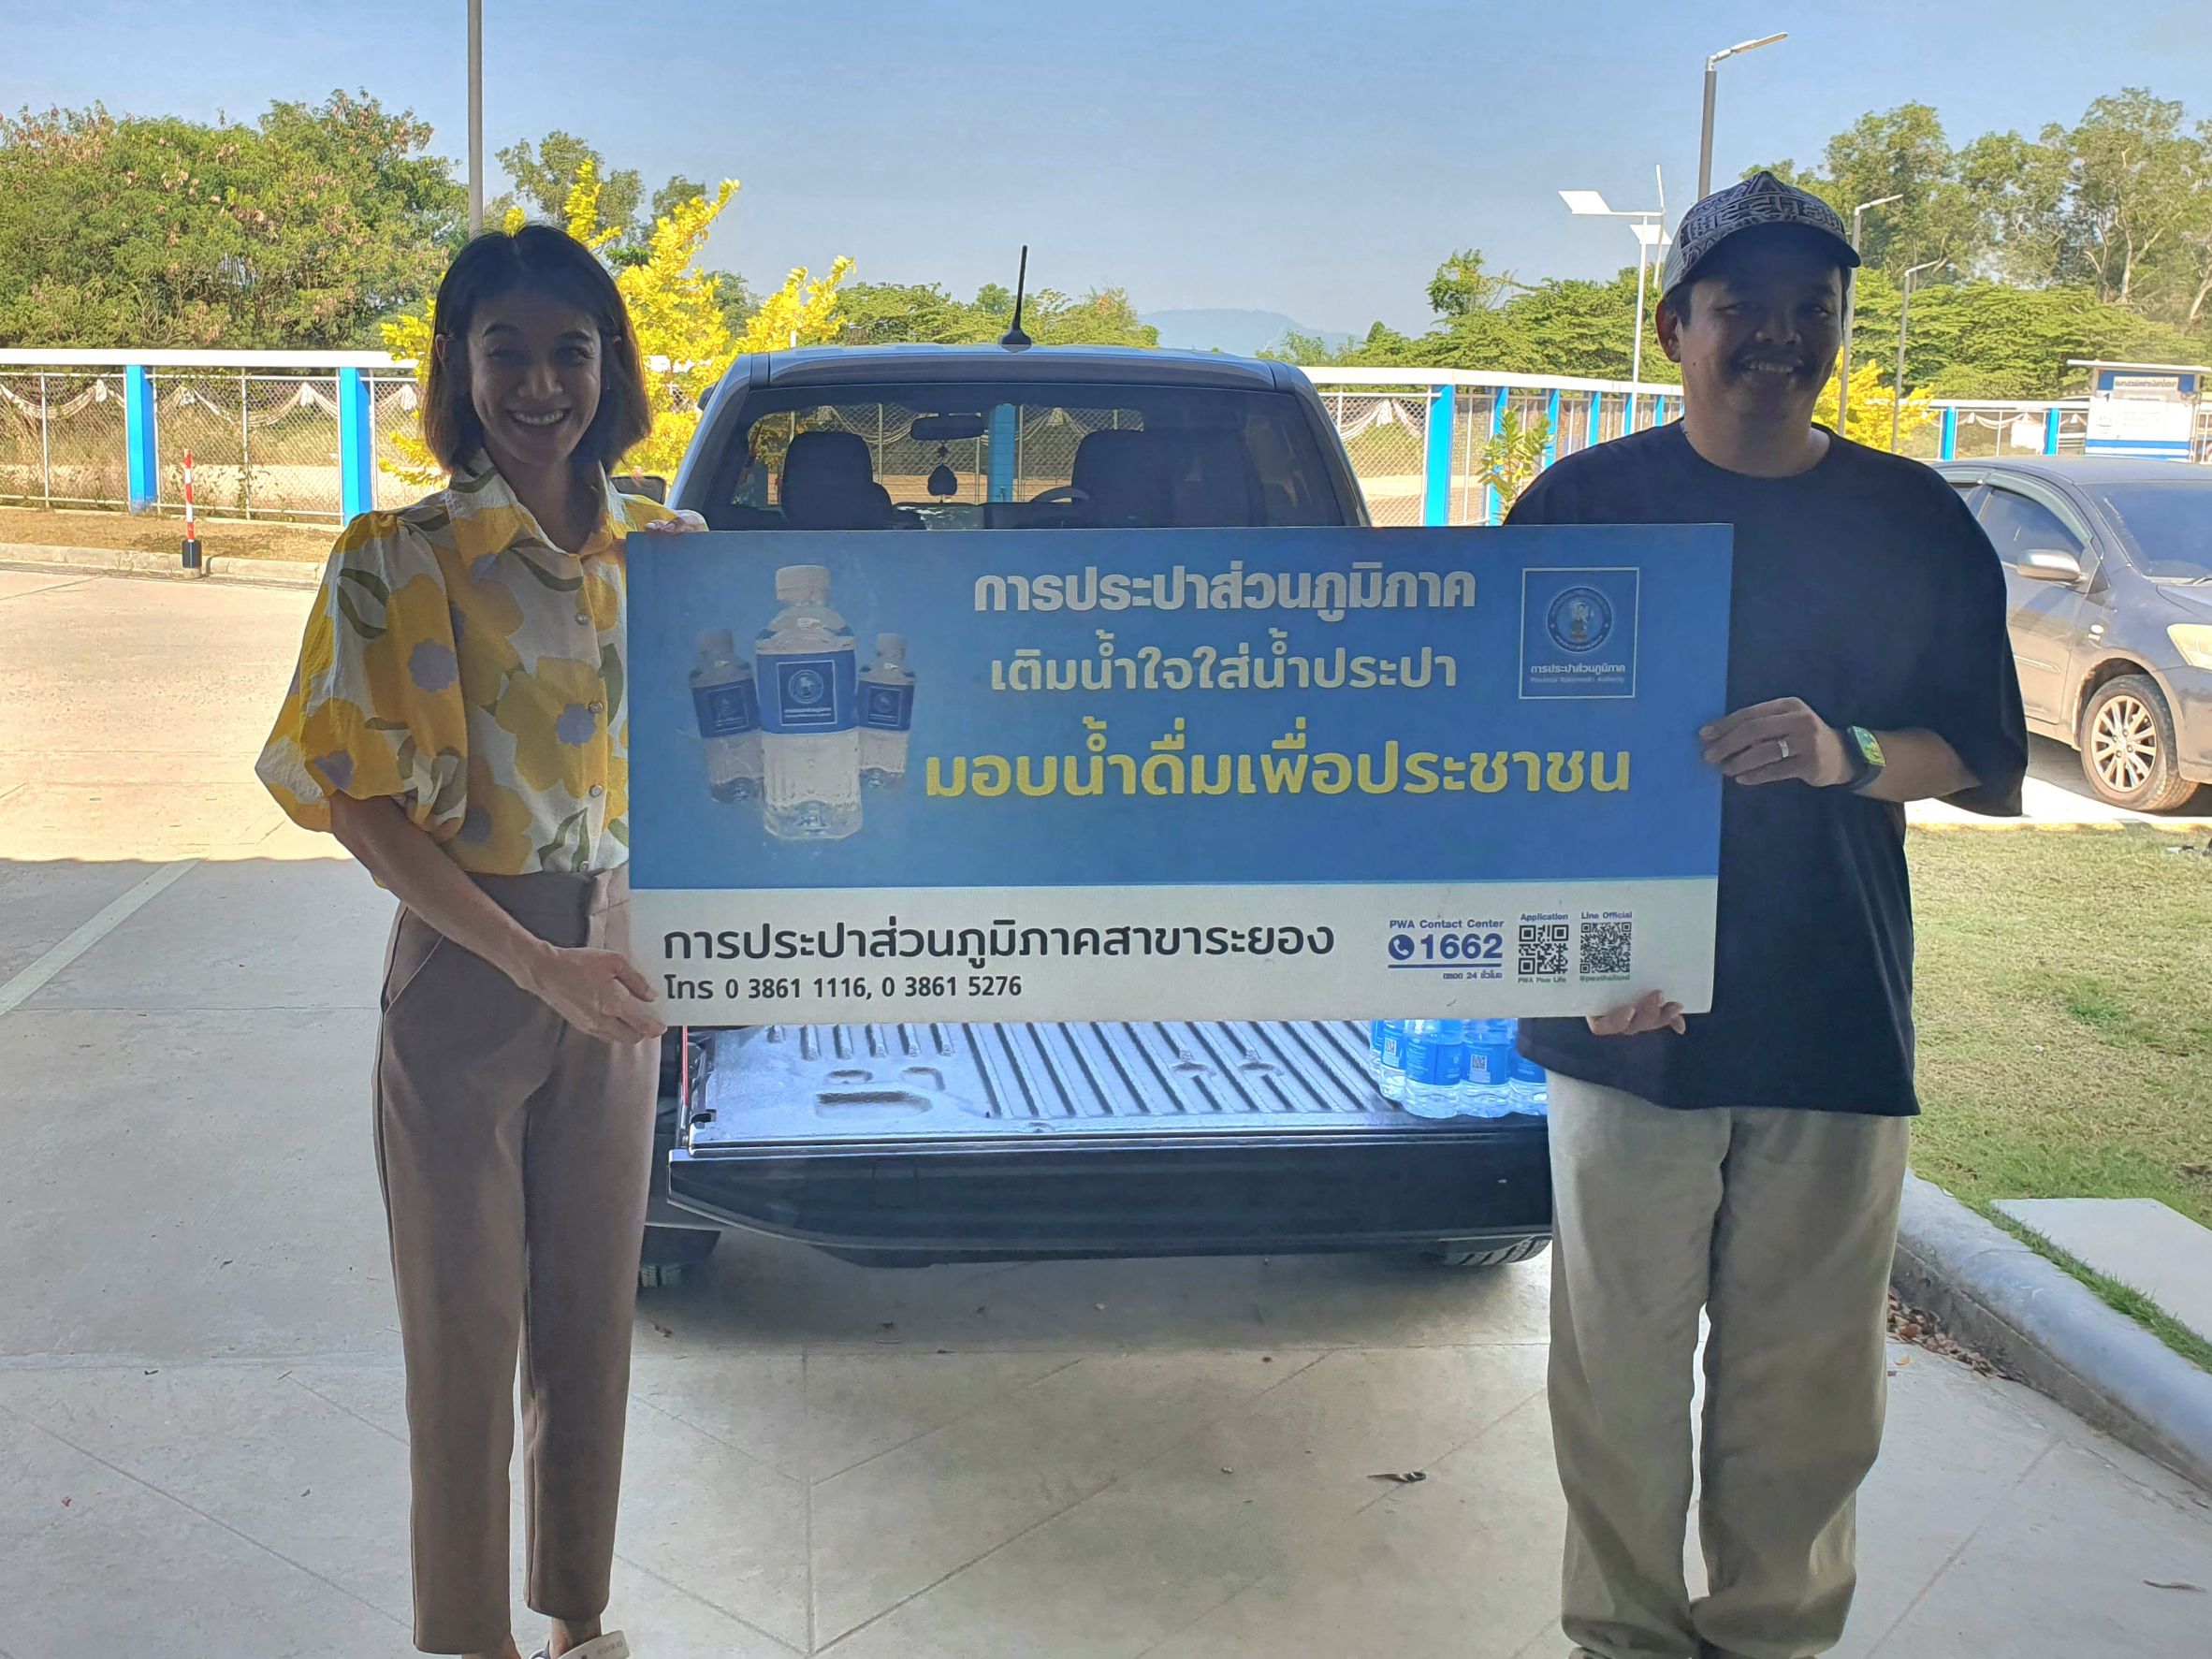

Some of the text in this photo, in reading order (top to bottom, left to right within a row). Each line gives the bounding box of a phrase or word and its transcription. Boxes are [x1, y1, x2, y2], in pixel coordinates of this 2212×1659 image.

[974, 561, 1477, 622] การประปาส่วนภูมิภาค
[990, 628, 1457, 691] เติมน้ำใจใส่น้ำประปา
[925, 715, 1631, 798] มอบน้ำดื่มเพื่อประชาชน
[1390, 919, 1505, 929] PWA Contact Center
[1521, 912, 1569, 923] Application
[1580, 911, 1599, 920] Line
[663, 916, 1334, 968] การประปาส่วนภูมิภาคสาขาระยอง
[1420, 933, 1503, 960] 1662
[664, 974, 1022, 1001] โทร 0 3861 1116, 0 3861 5276
